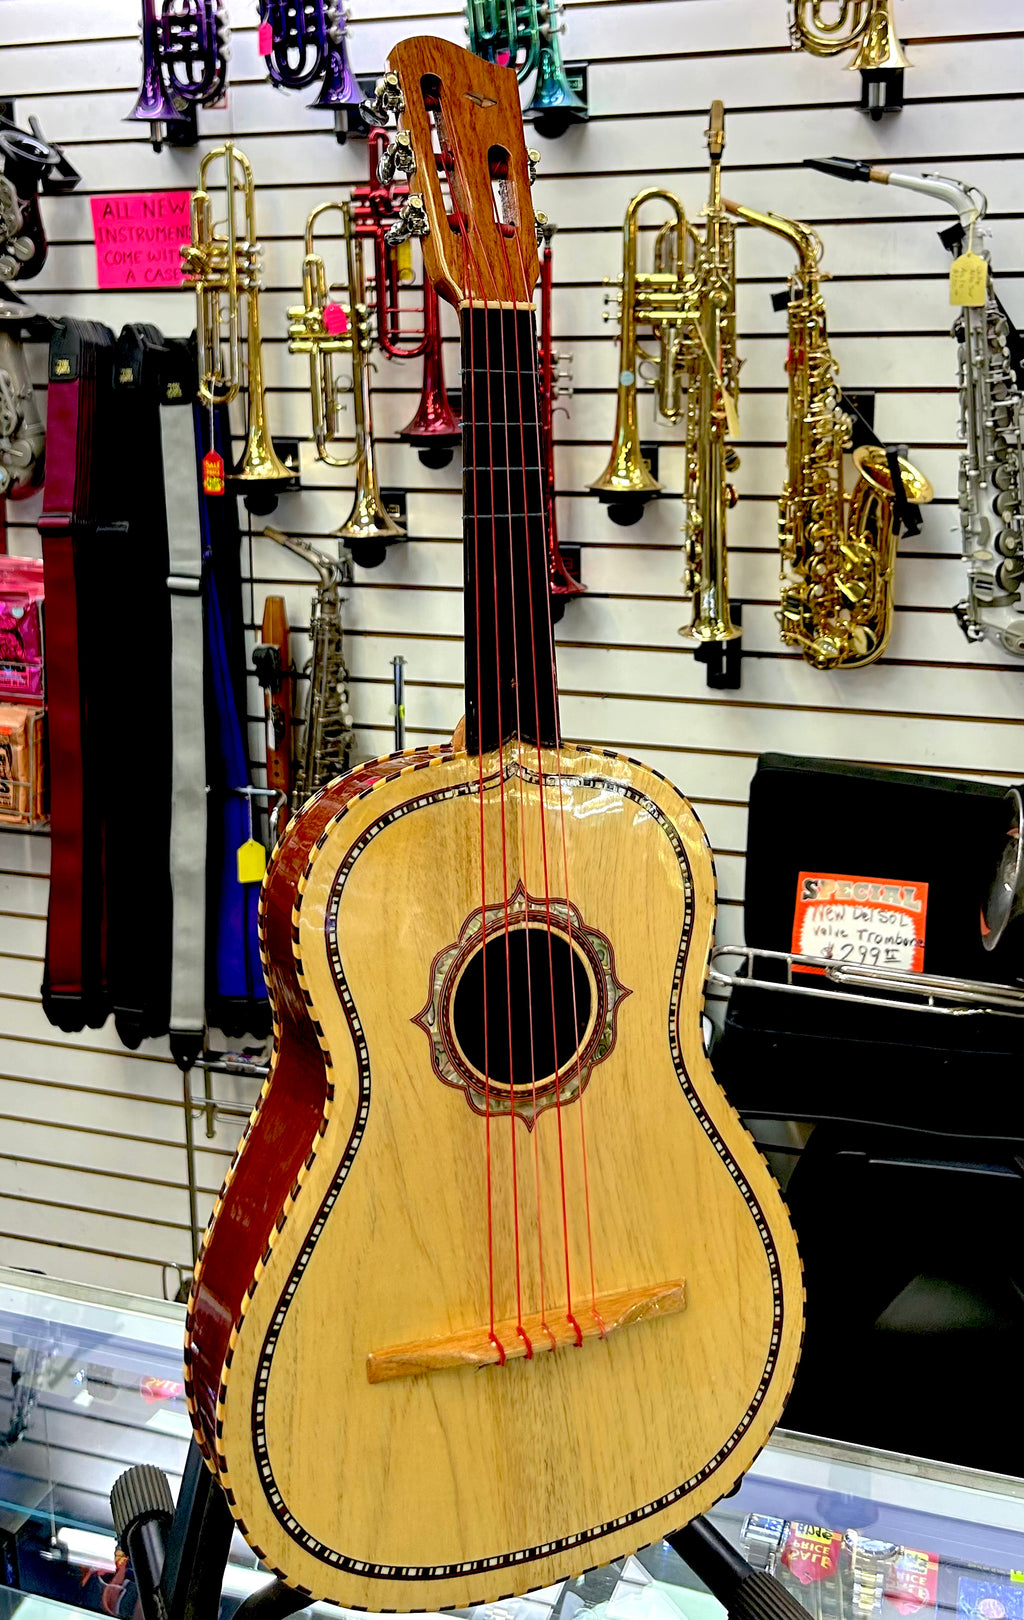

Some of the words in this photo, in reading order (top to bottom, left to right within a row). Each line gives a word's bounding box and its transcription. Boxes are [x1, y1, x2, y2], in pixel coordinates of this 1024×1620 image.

[103, 201, 134, 220] ALL
[144, 199, 186, 217] NEW
[104, 250, 141, 265] COME
[126, 269, 136, 283] A
[144, 268, 181, 282] CASE
[802, 878, 921, 912] SPECIAL
[857, 929, 925, 947] Trombone
